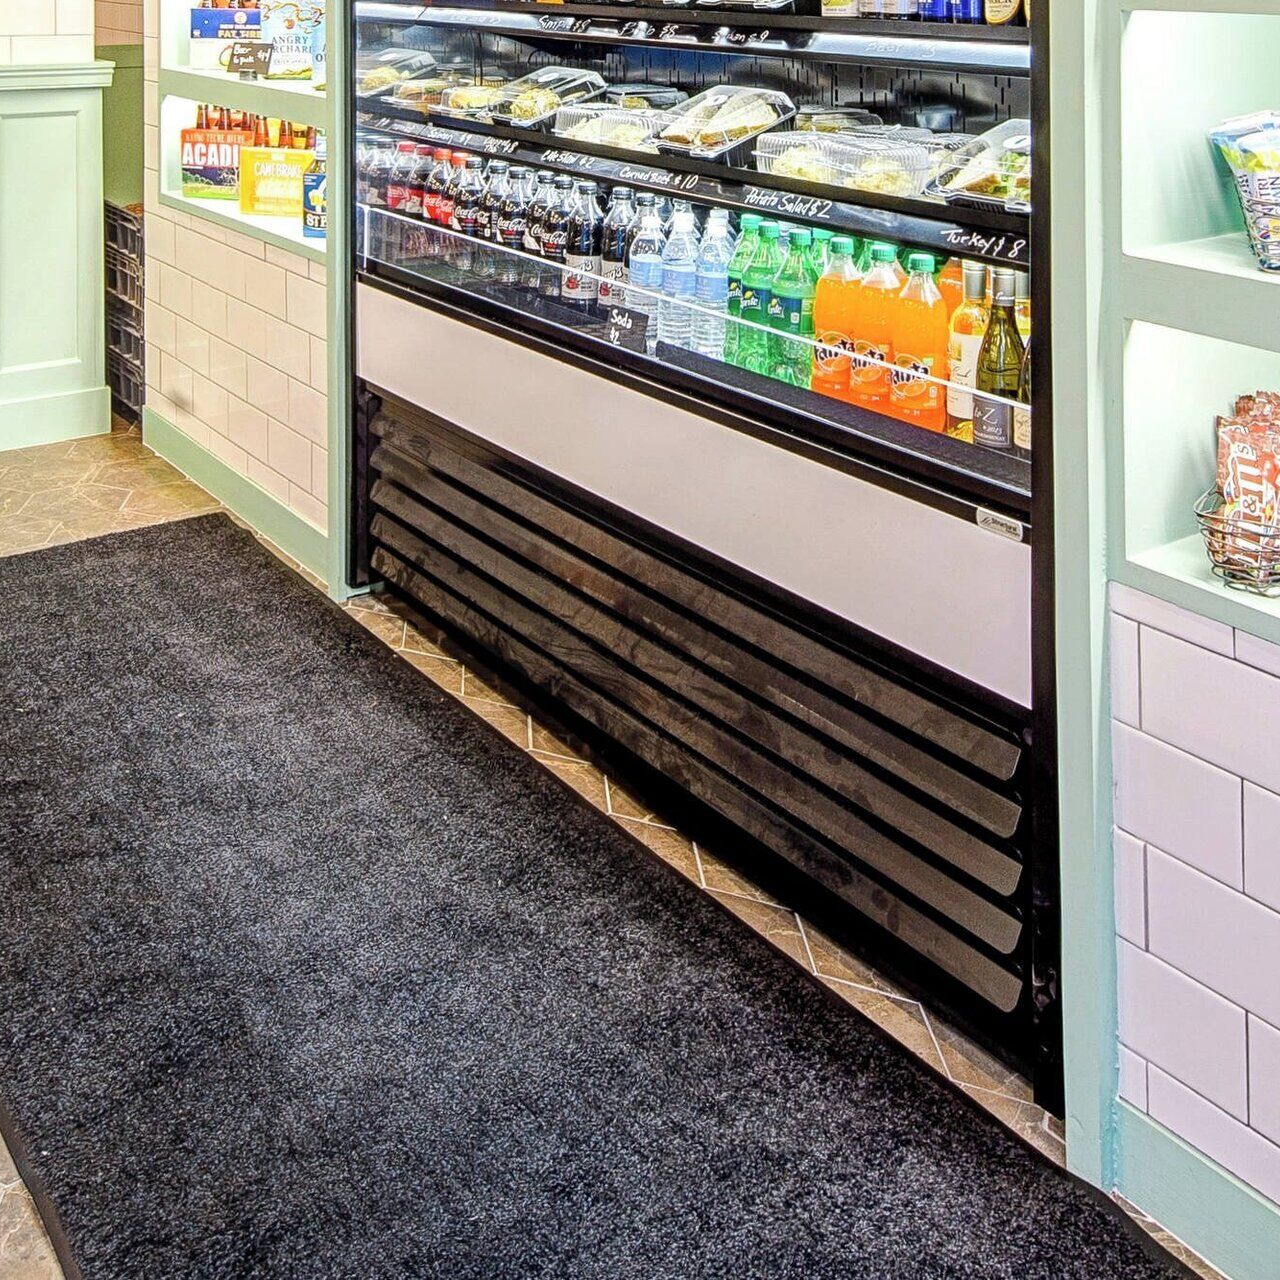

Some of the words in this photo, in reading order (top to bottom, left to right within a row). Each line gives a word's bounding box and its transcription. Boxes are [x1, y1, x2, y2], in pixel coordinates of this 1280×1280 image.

[272, 36, 309, 45] ANGRY
[659, 22, 679, 38] $8
[182, 143, 240, 166] ACADI
[620, 166, 651, 181] Corned
[651, 170, 672, 184] Beef
[746, 187, 777, 207] Potato
[777, 192, 808, 216] Salad
[808, 199, 832, 219] $2
[940, 227, 993, 256] Turkey
[611, 308, 633, 329] Soda
